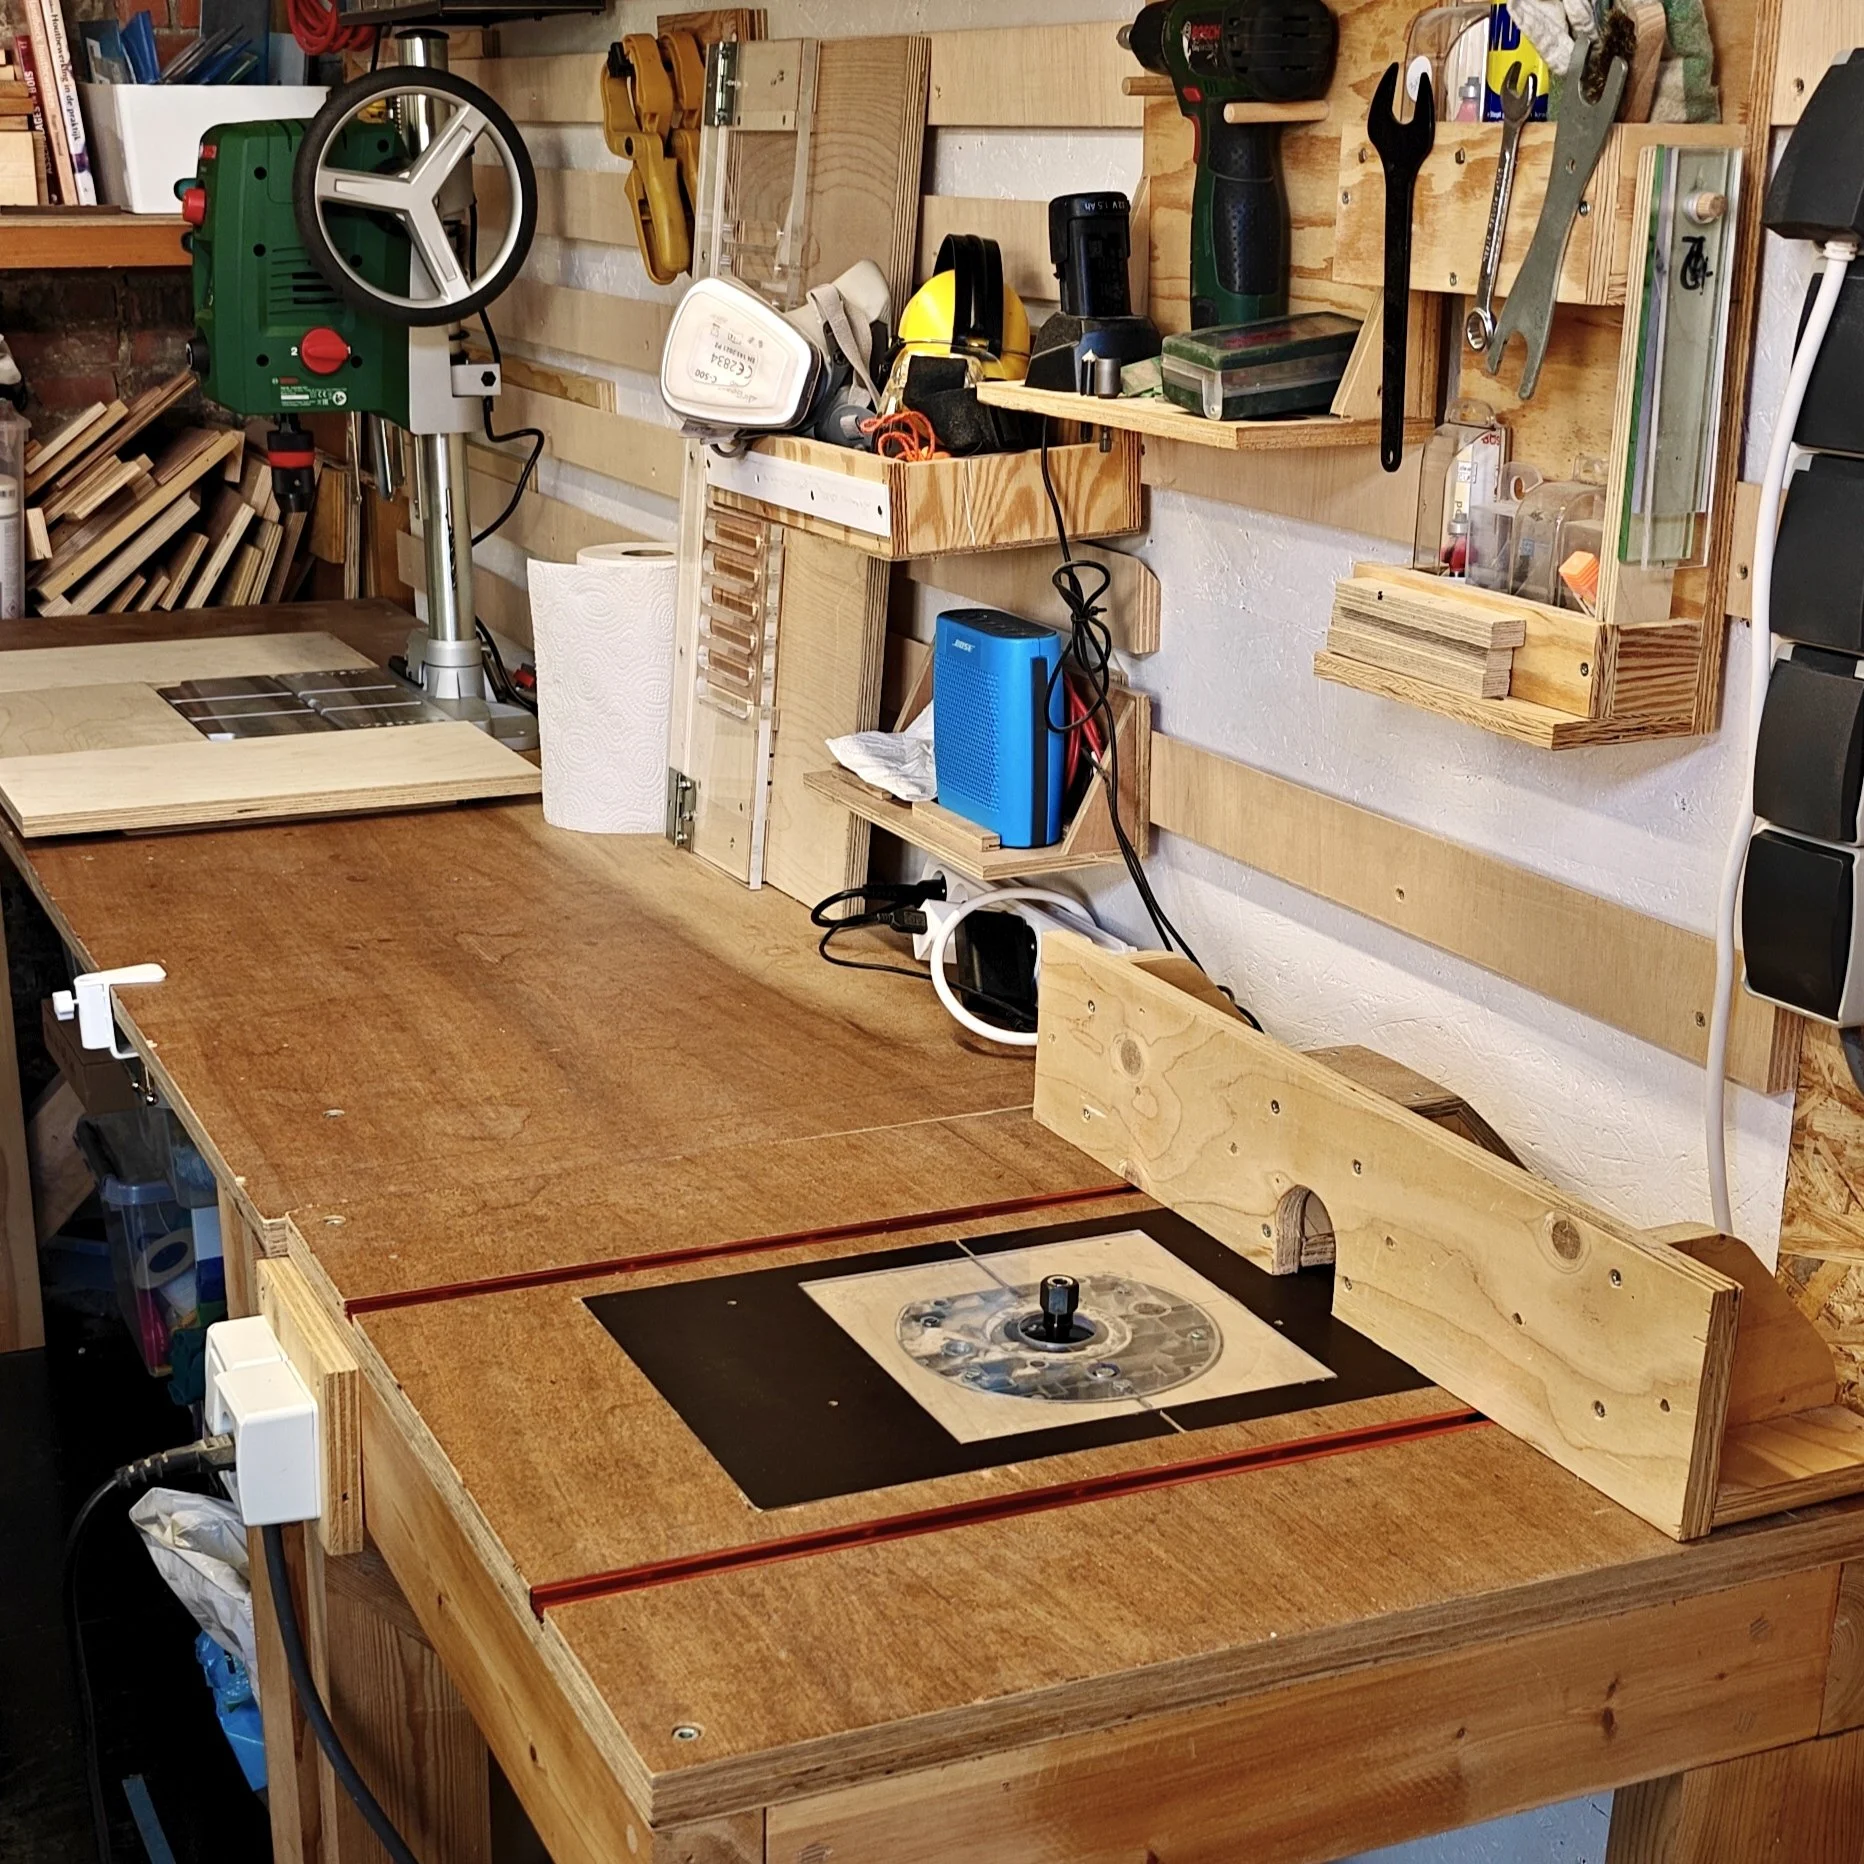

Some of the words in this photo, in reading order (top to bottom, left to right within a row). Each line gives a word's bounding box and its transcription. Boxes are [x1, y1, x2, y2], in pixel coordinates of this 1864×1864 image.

[1191, 24, 1222, 40] BOSCH
[51, 14, 69, 82] Houtbewerking
[24, 71, 37, 94] BOIS
[64, 84, 71, 93] in
[66, 95, 74, 106] de
[67, 108, 81, 141] praktijk
[291, 346, 298, 356] 2
[694, 369, 718, 384] C-500
[952, 639, 976, 653] BOSE
